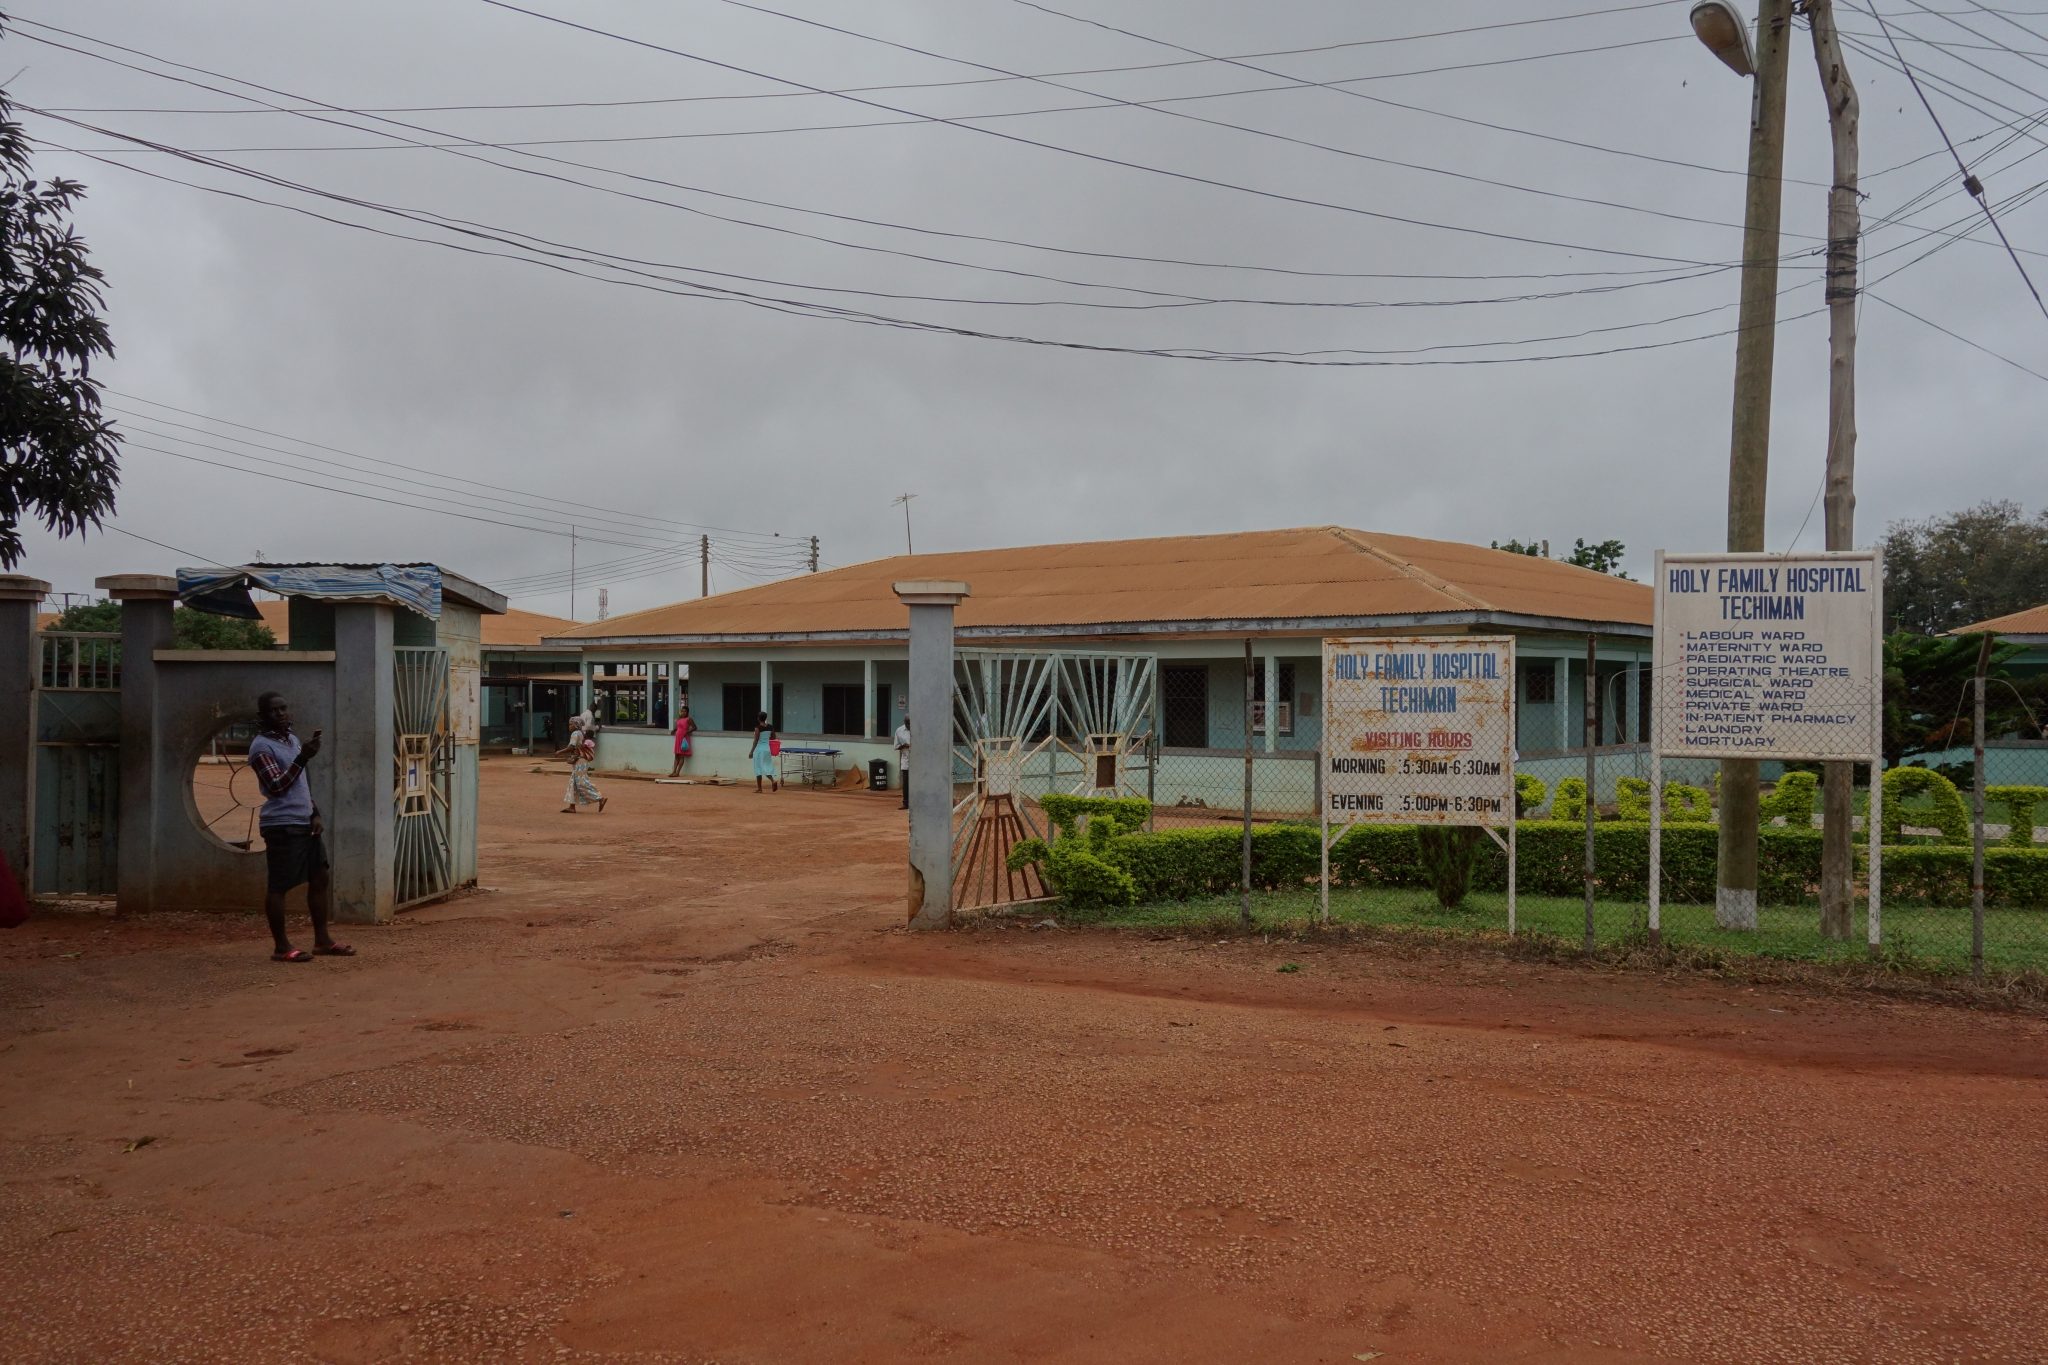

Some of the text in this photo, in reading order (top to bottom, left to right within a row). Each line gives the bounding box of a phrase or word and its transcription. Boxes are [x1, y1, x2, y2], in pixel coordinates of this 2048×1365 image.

[1669, 568, 1866, 593] HOLY FAMILY HOSPITAL
[1720, 596, 1805, 620] TECHIMAN
[1687, 631, 1805, 640] LABOUR WARD
[1686, 643, 1823, 652] MATERNITY WARD
[1686, 655, 1827, 664] PAEDIATRIC WARD
[1335, 653, 1500, 680] HOLY FAMILY HOSPITAL
[1686, 667, 1849, 676] OPERATING THEATRE
[1686, 679, 1813, 688] SURGICAL WARD
[1686, 690, 1806, 699] MEDICAL WARD
[1379, 686, 1457, 713] TECHIMAN
[1686, 702, 1803, 711] PRIVATE WARD
[1685, 713, 1856, 724] IN-PATIENT PHARMACY
[1685, 725, 1763, 734] LAUNDRY
[1365, 732, 1472, 748] VISITING HOURS
[1685, 737, 1776, 746] MORTUARY
[1331, 759, 1386, 773] MORNING
[1331, 795, 1383, 810] EVENING
